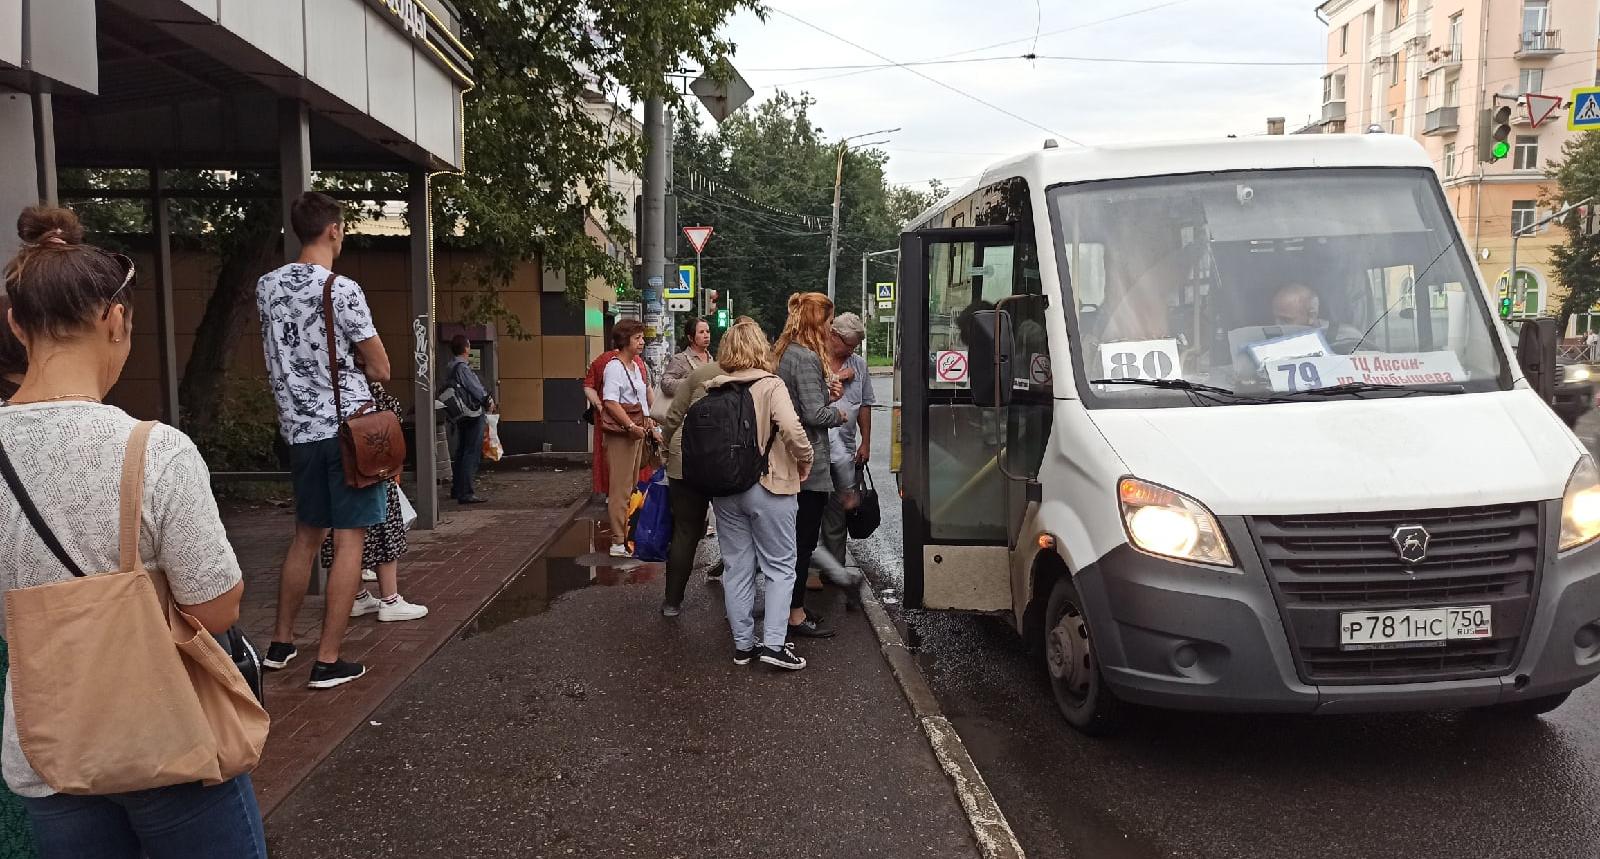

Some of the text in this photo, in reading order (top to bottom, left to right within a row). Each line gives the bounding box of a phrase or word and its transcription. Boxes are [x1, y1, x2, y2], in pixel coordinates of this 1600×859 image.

[1111, 351, 1173, 380] 80
[1277, 356, 1323, 392] 79
[1350, 356, 1371, 374] ТЦ
[1450, 610, 1484, 629] 750
[1457, 627, 1475, 636] RUS
